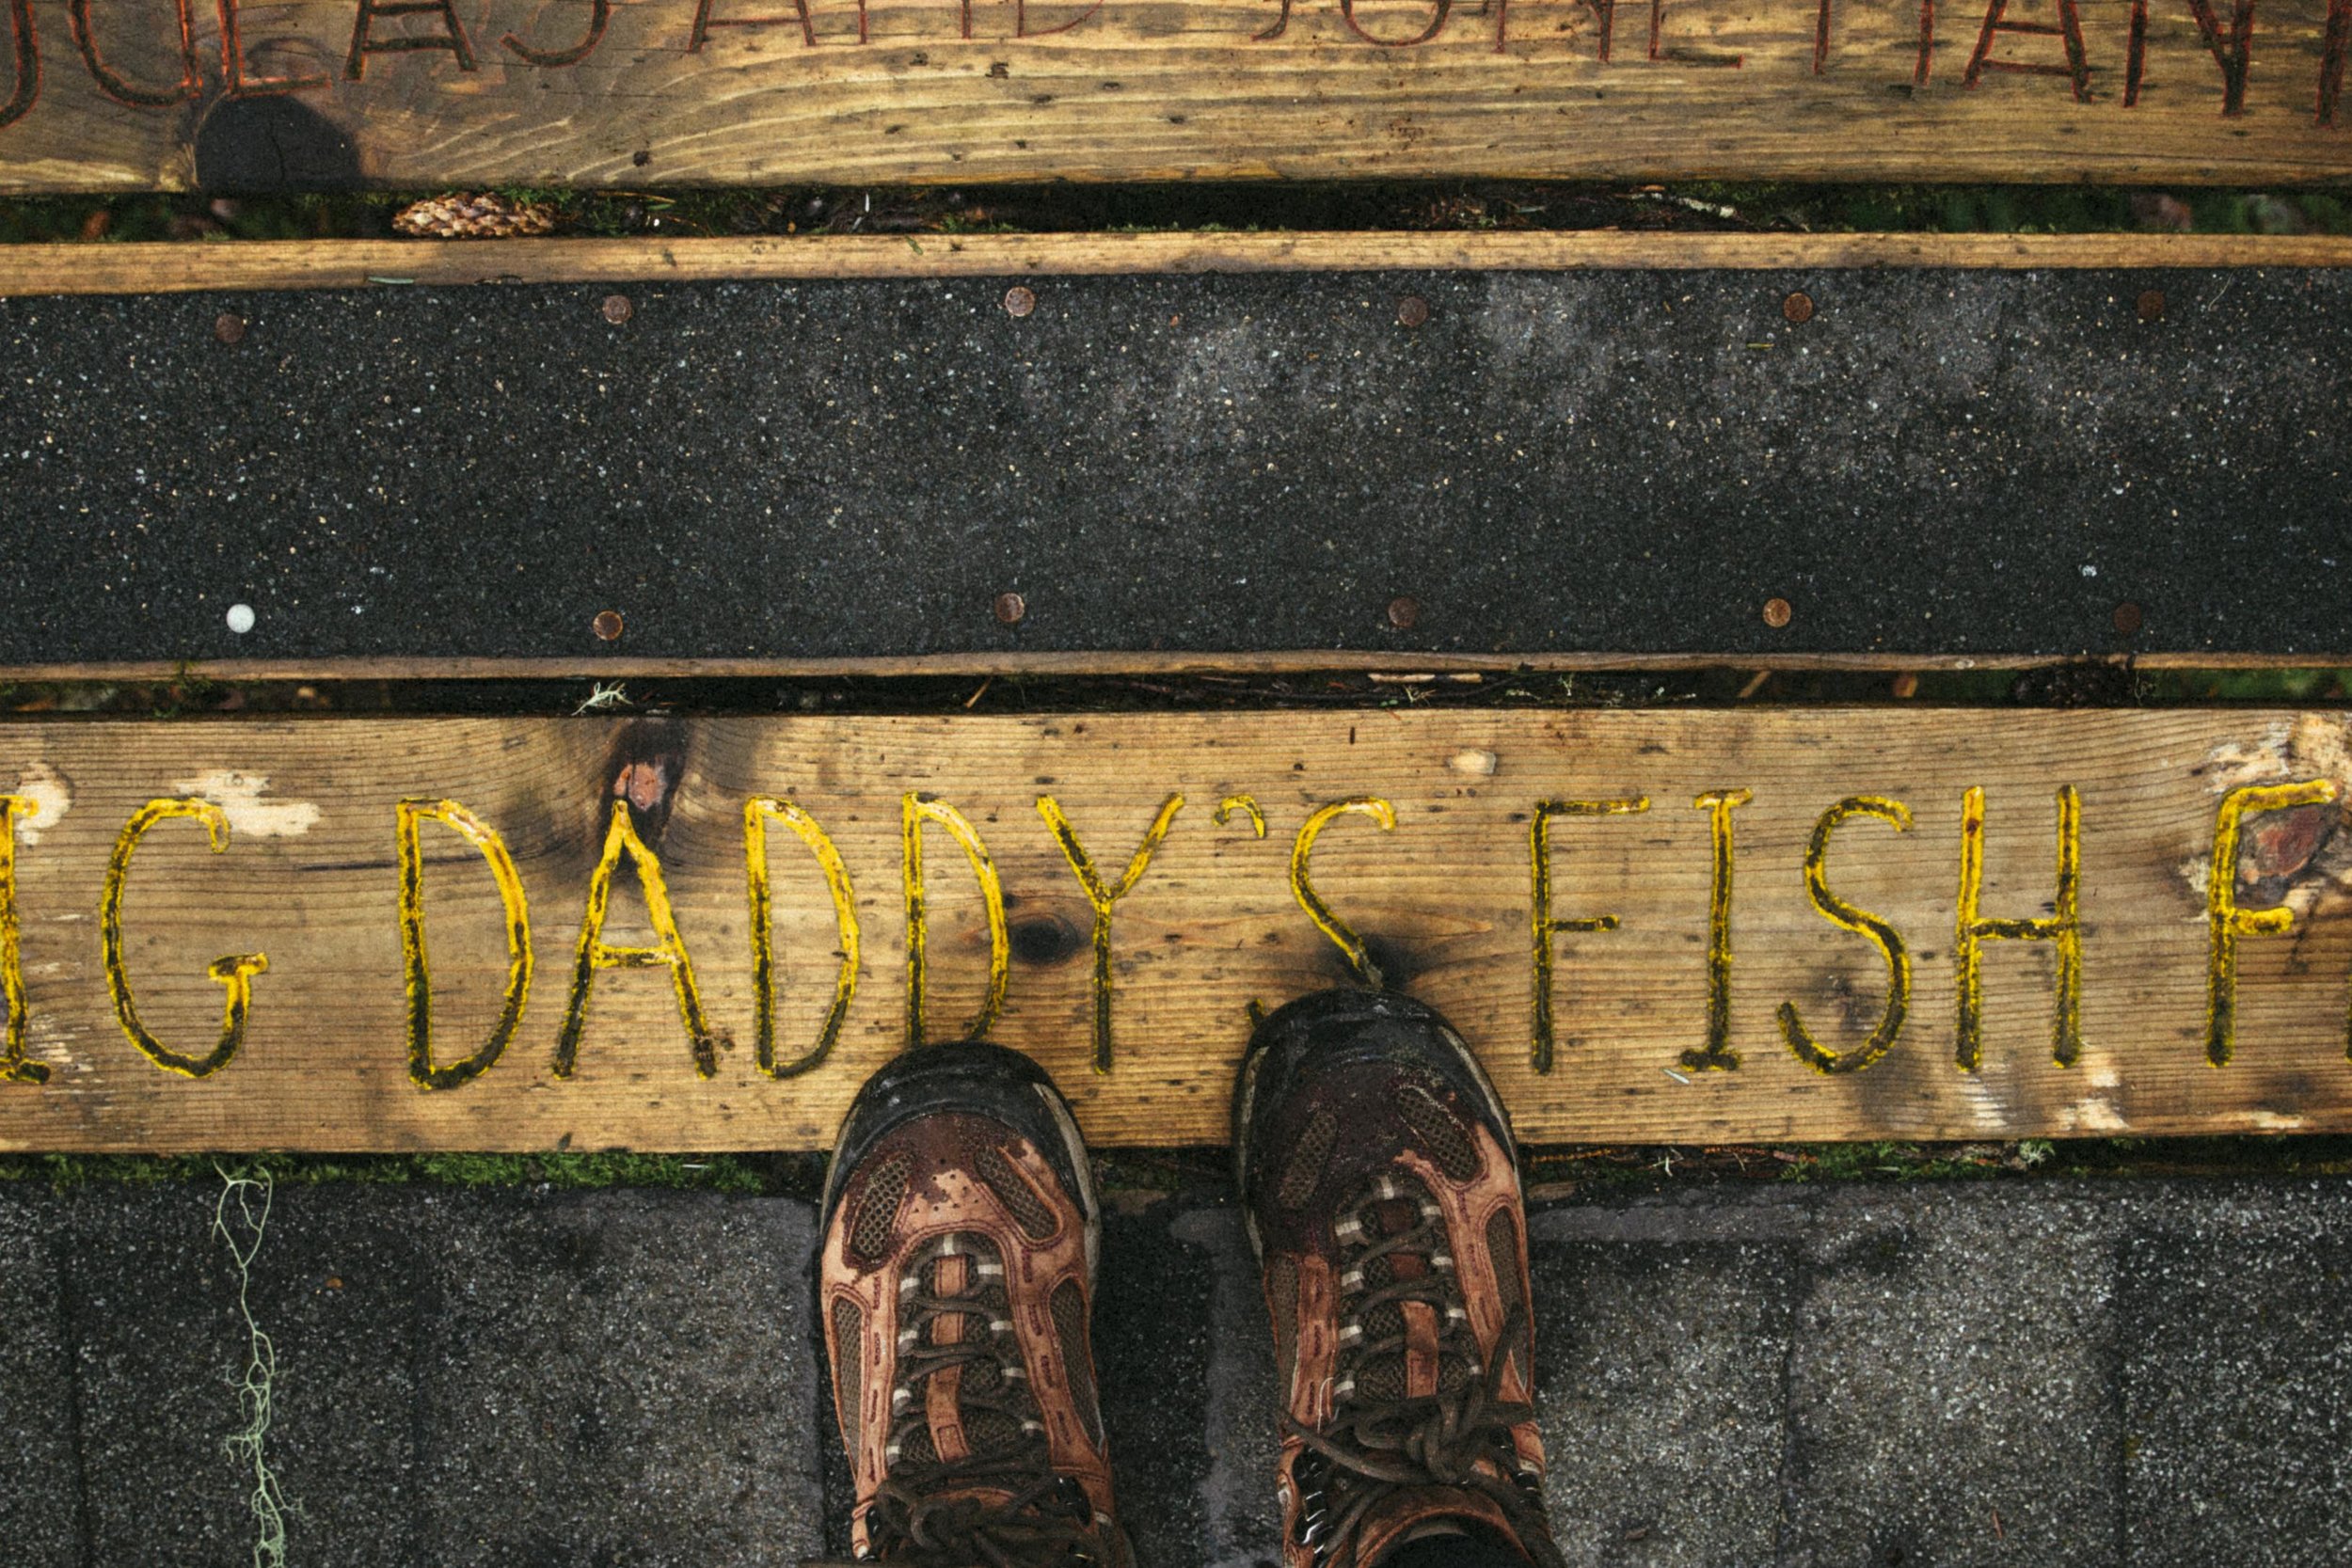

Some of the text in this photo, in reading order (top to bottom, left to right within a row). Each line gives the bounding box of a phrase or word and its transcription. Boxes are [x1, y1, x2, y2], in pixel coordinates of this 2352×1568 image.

[396, 791, 1397, 1089] DADDY'S
[1531, 784, 2081, 1075] FISH
[2206, 778, 2352, 1069] F
